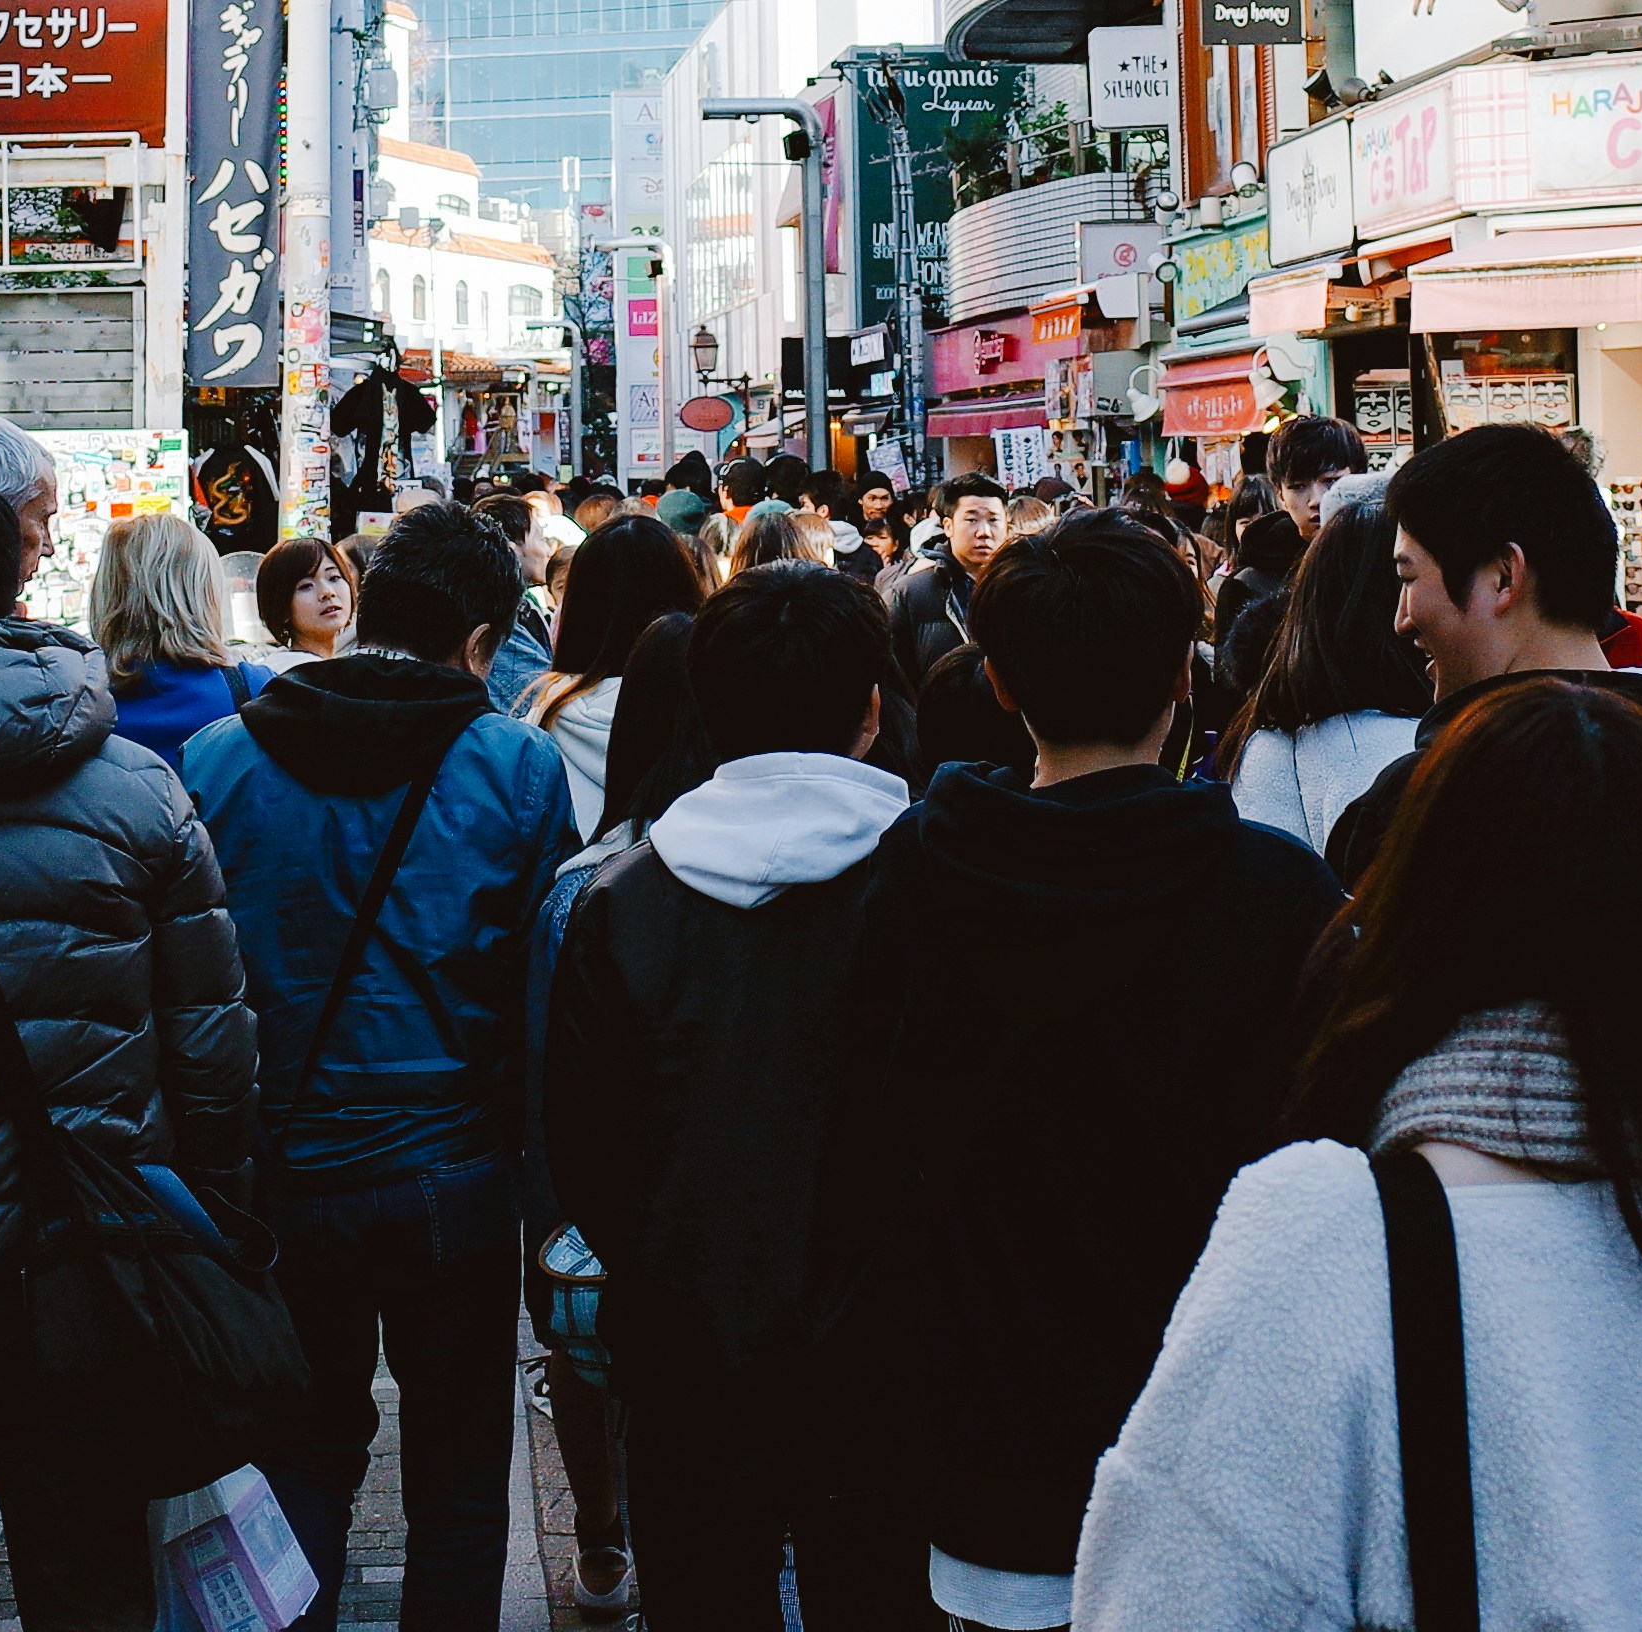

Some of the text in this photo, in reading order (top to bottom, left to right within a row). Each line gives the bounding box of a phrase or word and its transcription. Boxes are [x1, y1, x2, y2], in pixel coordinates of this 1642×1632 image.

[1215, 1, 1291, 28] Drug honey
[1132, 55, 1158, 75] THE
[193, 0, 275, 382] ギャラリー ハセガワ
